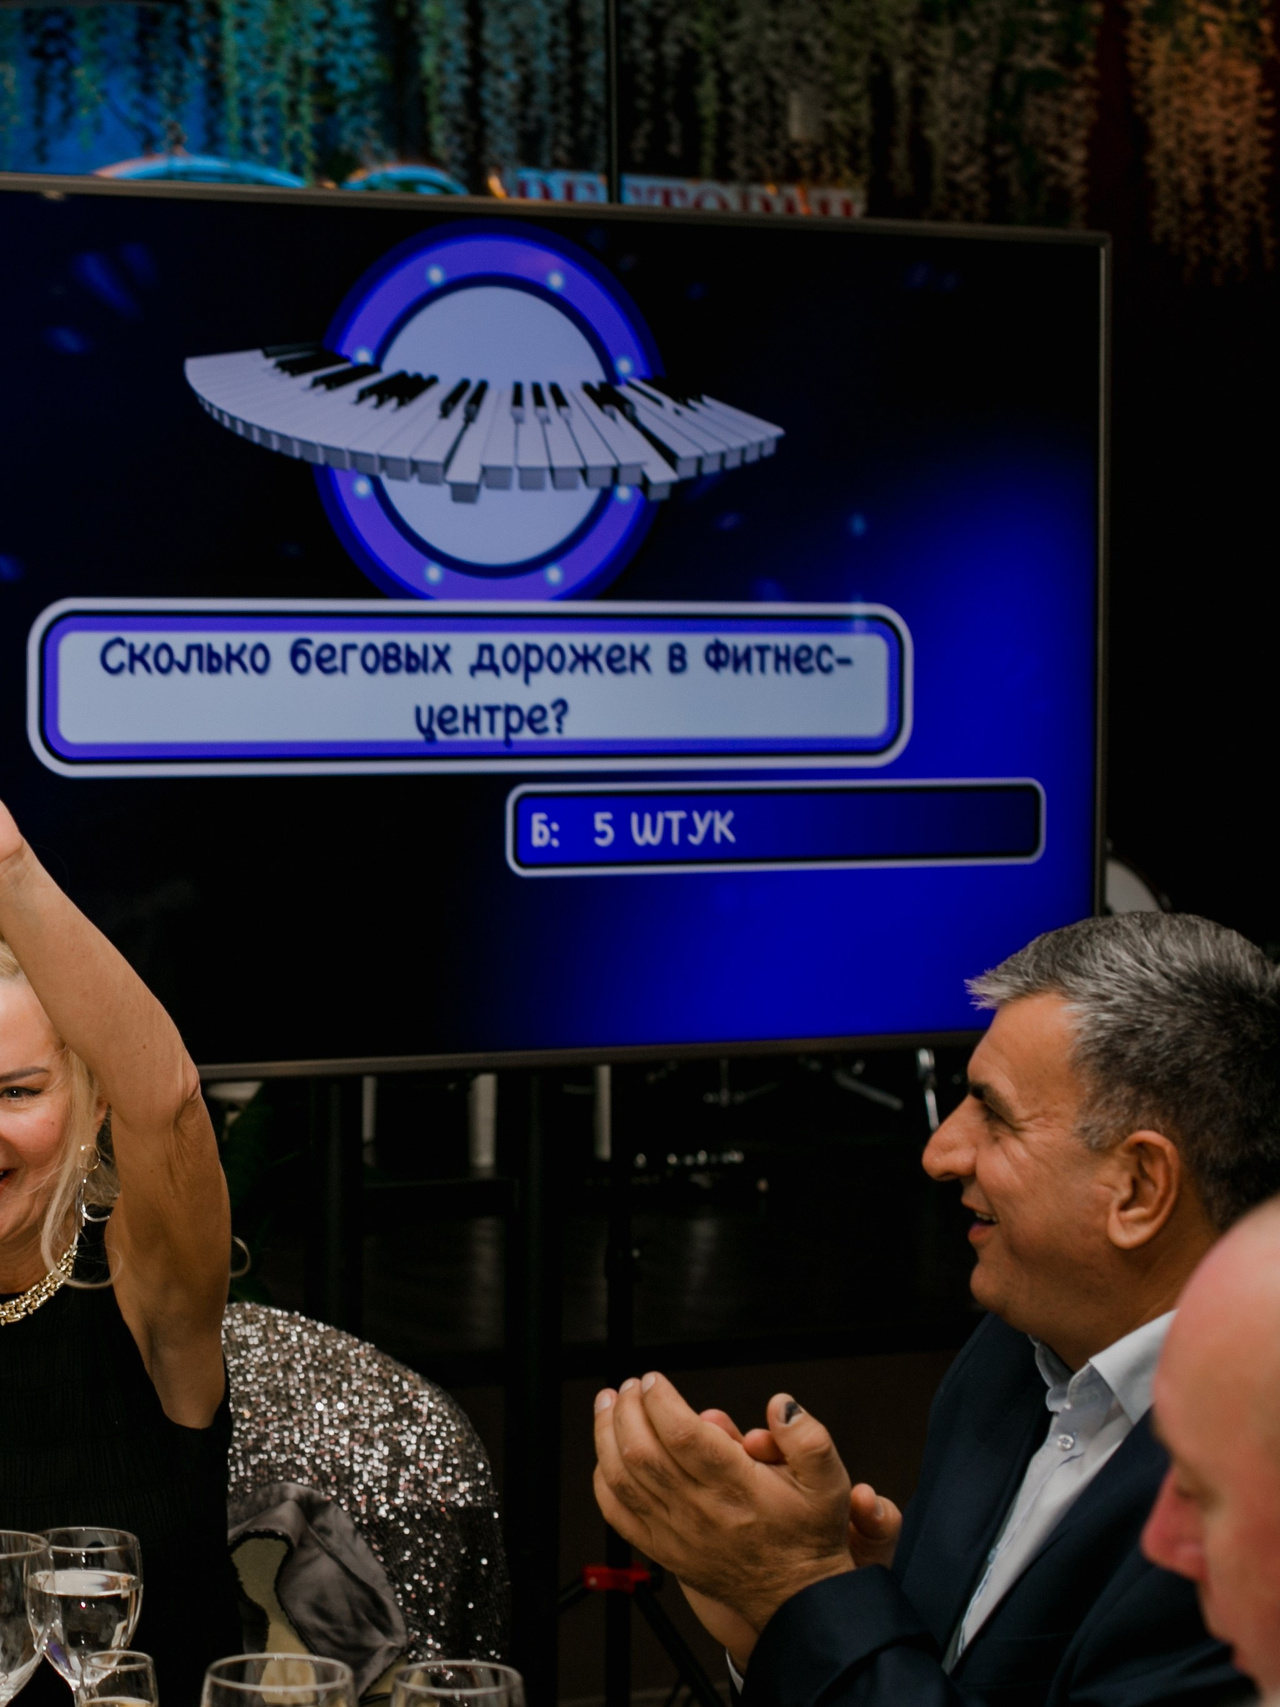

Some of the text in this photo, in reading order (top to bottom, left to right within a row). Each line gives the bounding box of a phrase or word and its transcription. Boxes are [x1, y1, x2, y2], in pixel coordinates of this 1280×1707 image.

[100, 636, 270, 676] Сколько
[289, 637, 453, 676] беговых
[469, 641, 652, 686] дорожек
[668, 641, 688, 675] в
[415, 698, 569, 748] центре?
[531, 810, 736, 848] Б: 5 ШТУК
